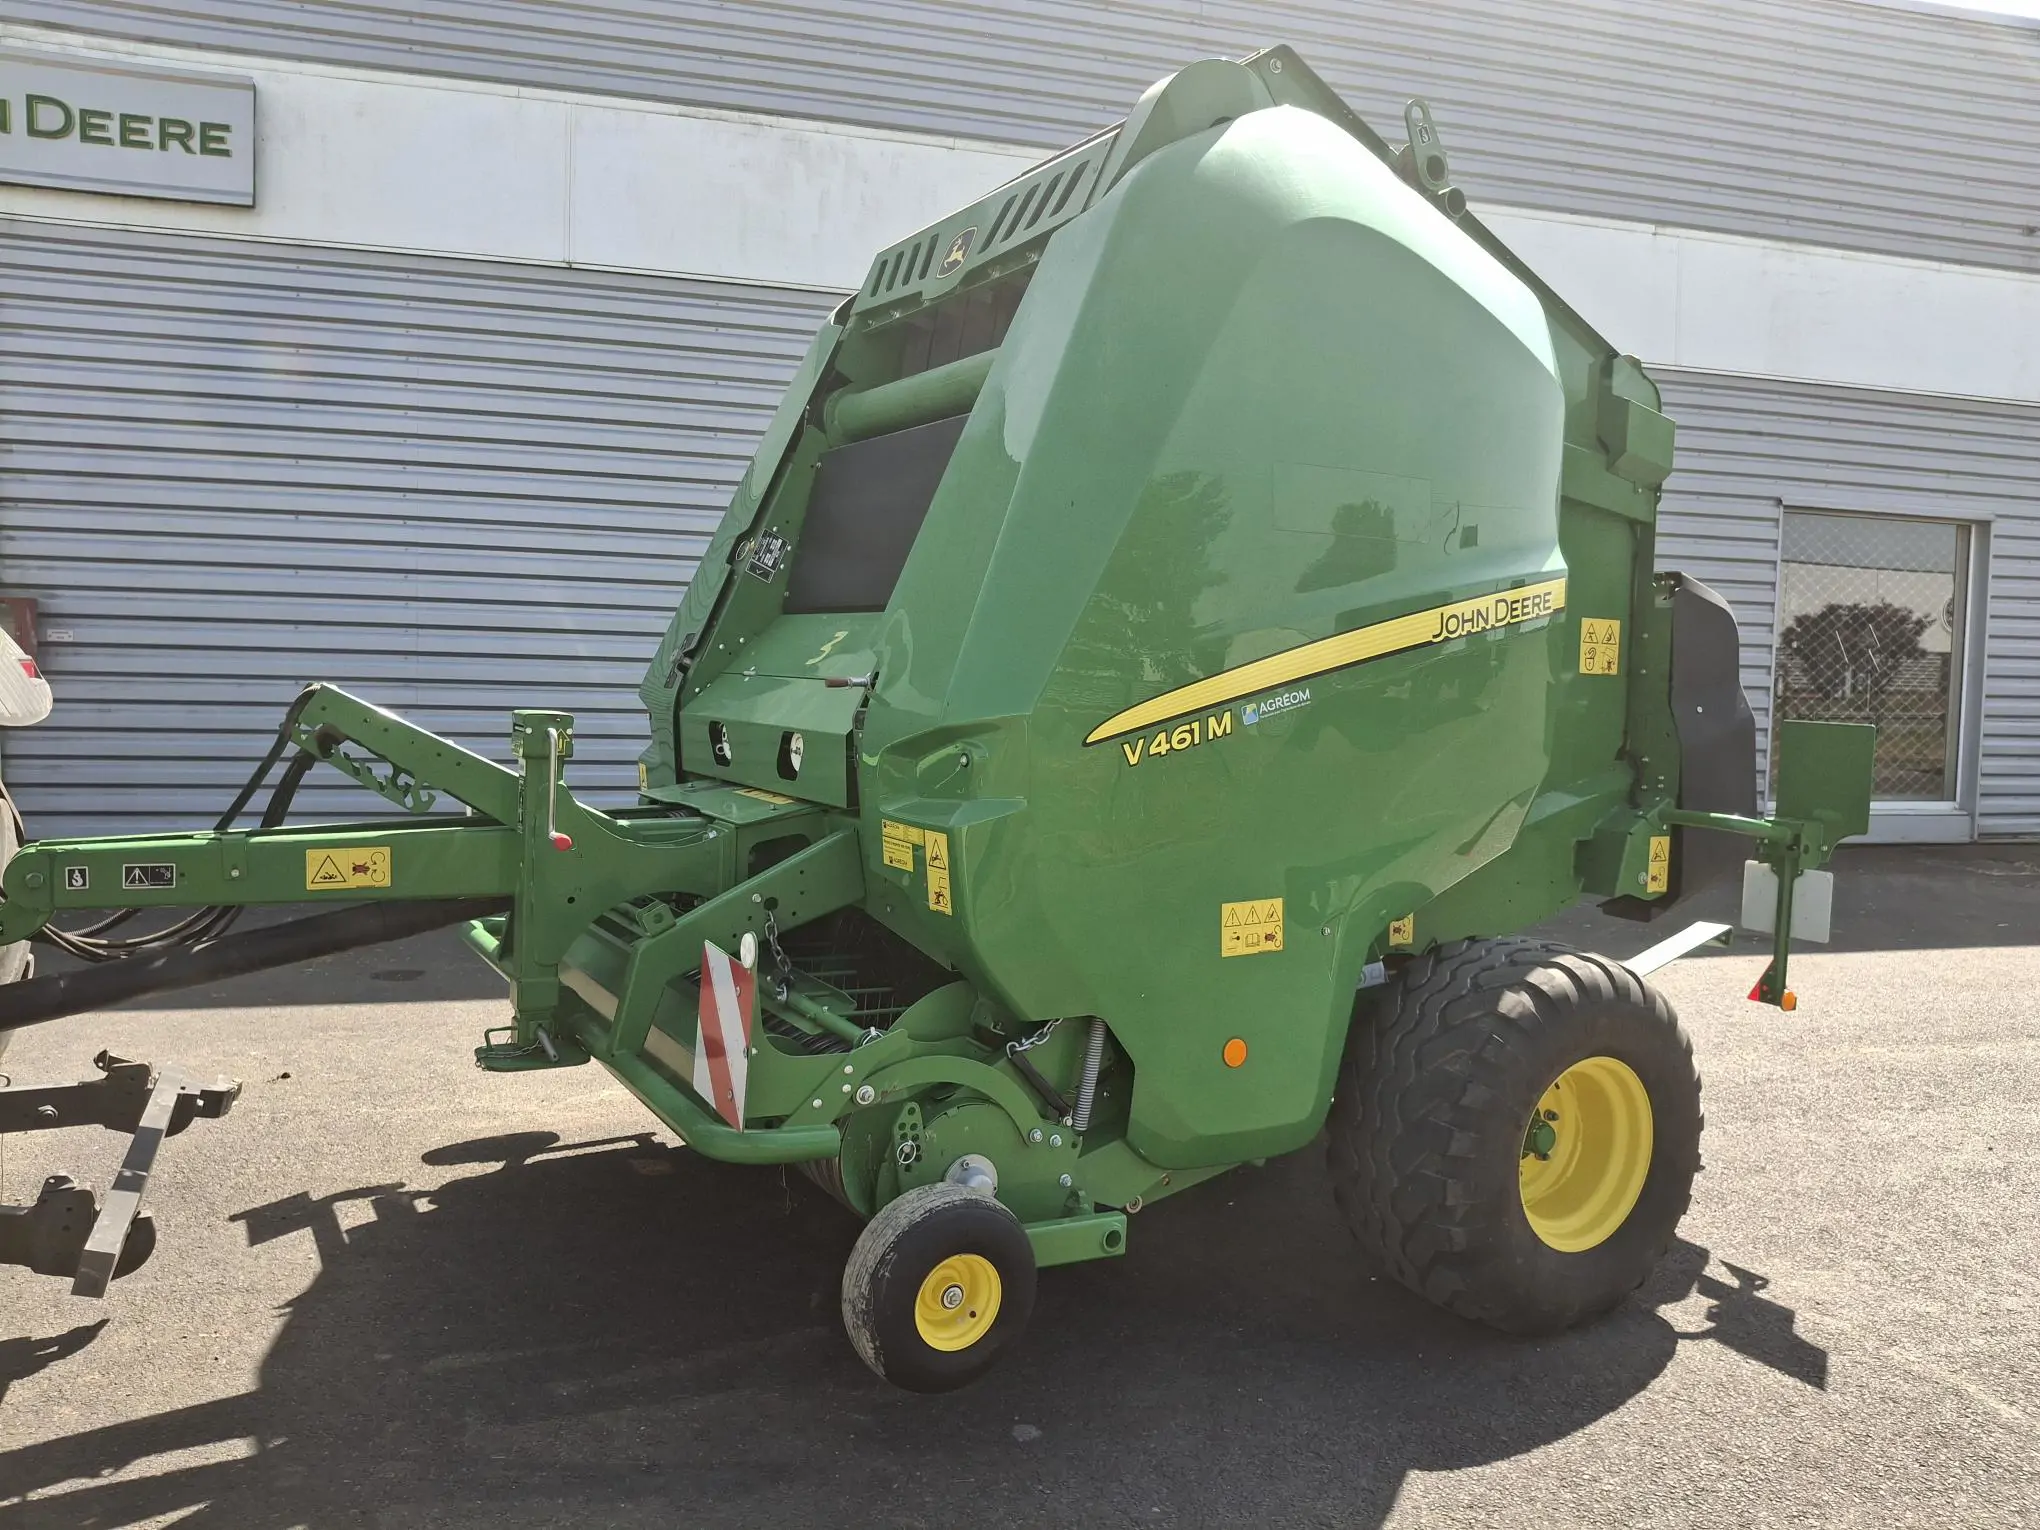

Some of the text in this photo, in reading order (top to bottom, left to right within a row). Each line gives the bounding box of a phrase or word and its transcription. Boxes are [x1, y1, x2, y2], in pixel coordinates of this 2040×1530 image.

[26, 93, 233, 158] DEERE
[1431, 591, 1553, 640] JOHN DEERE
[1260, 688, 1311, 715] AGRÉOM
[1121, 710, 1232, 767] V 461 M
